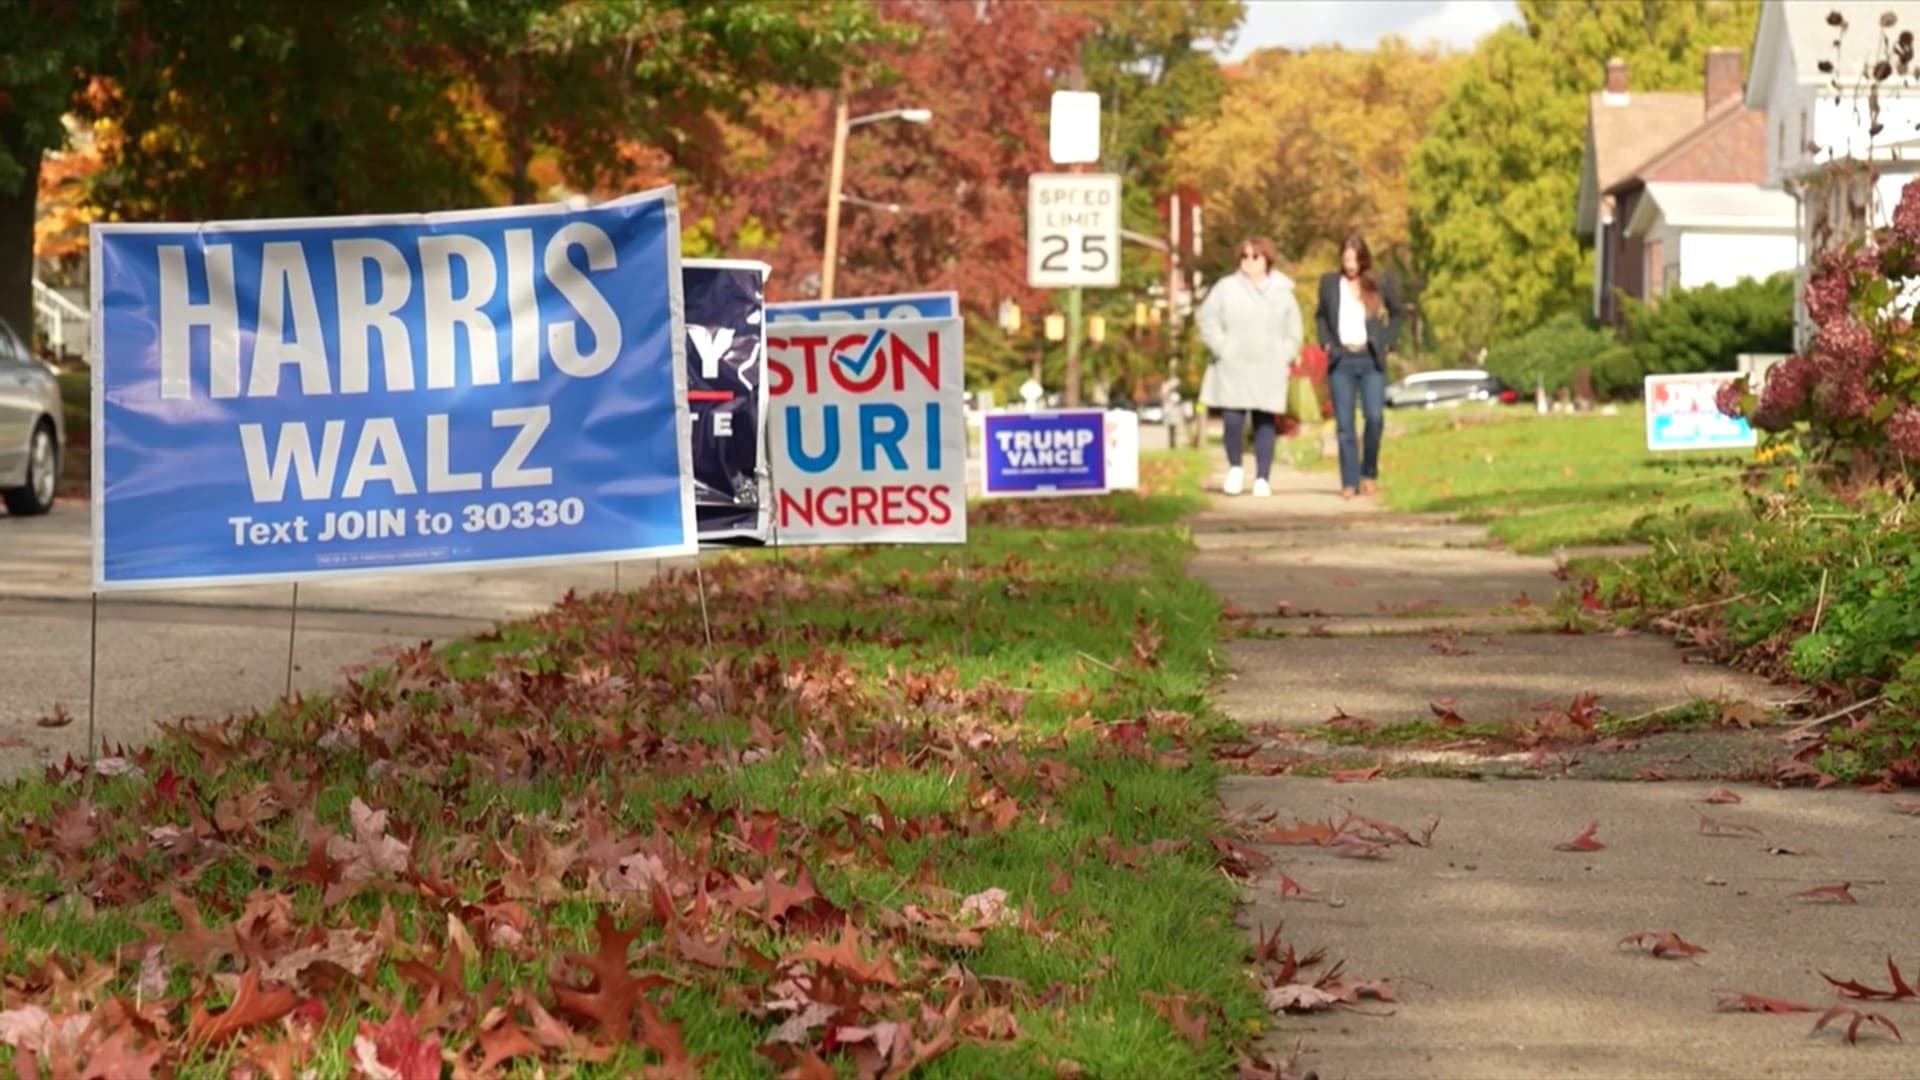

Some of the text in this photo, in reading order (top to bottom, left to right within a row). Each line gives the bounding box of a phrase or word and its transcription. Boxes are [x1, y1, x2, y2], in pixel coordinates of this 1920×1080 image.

[1046, 211, 1101, 227] LIMIT
[1040, 235, 1109, 272] 25
[156, 221, 622, 399] HARRIS
[239, 405, 553, 503] WALZ
[785, 402, 941, 473] URI
[995, 429, 1094, 451] TRUMP
[1006, 449, 1083, 467] VANCE
[228, 497, 585, 546] Text JOIN to 30330
[779, 484, 952, 528] NGRESS
